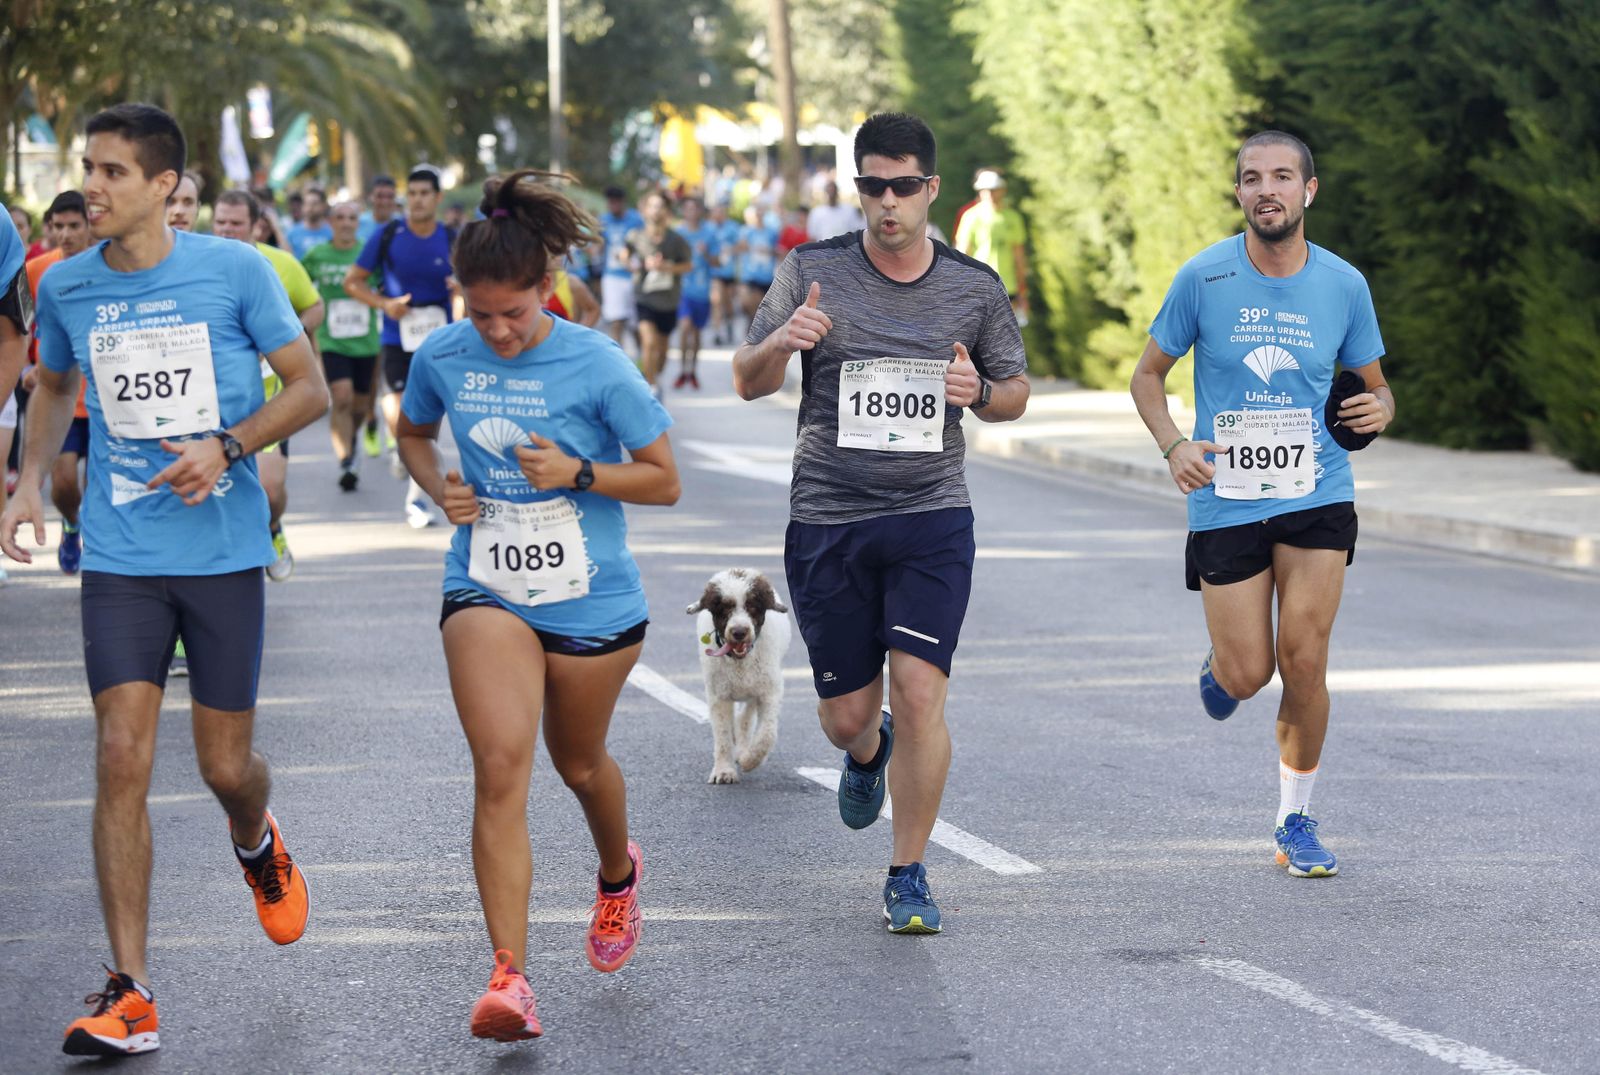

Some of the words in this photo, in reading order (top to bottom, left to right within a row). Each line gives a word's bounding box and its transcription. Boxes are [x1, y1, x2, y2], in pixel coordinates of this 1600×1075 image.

[1205, 270, 1228, 283] luanvi
[92, 320, 136, 333] CARRERA
[140, 314, 183, 327] URBANA
[1234, 325, 1275, 333] CARRERA
[1277, 326, 1311, 338] URBANA
[1230, 334, 1262, 343] CIUDAD
[1265, 335, 1277, 343] DE
[1279, 336, 1314, 349] MÁLAGA
[914, 361, 944, 369] URBANA
[114, 368, 192, 402] 2587
[457, 391, 502, 403] CARRERA
[505, 395, 546, 407] URBANA
[849, 391, 936, 420] 18908
[1245, 390, 1293, 406] Unicaja
[453, 402, 489, 414] CIUDAD
[491, 406, 503, 415] DE
[1225, 445, 1305, 469] 18907
[489, 541, 565, 572] 1089
